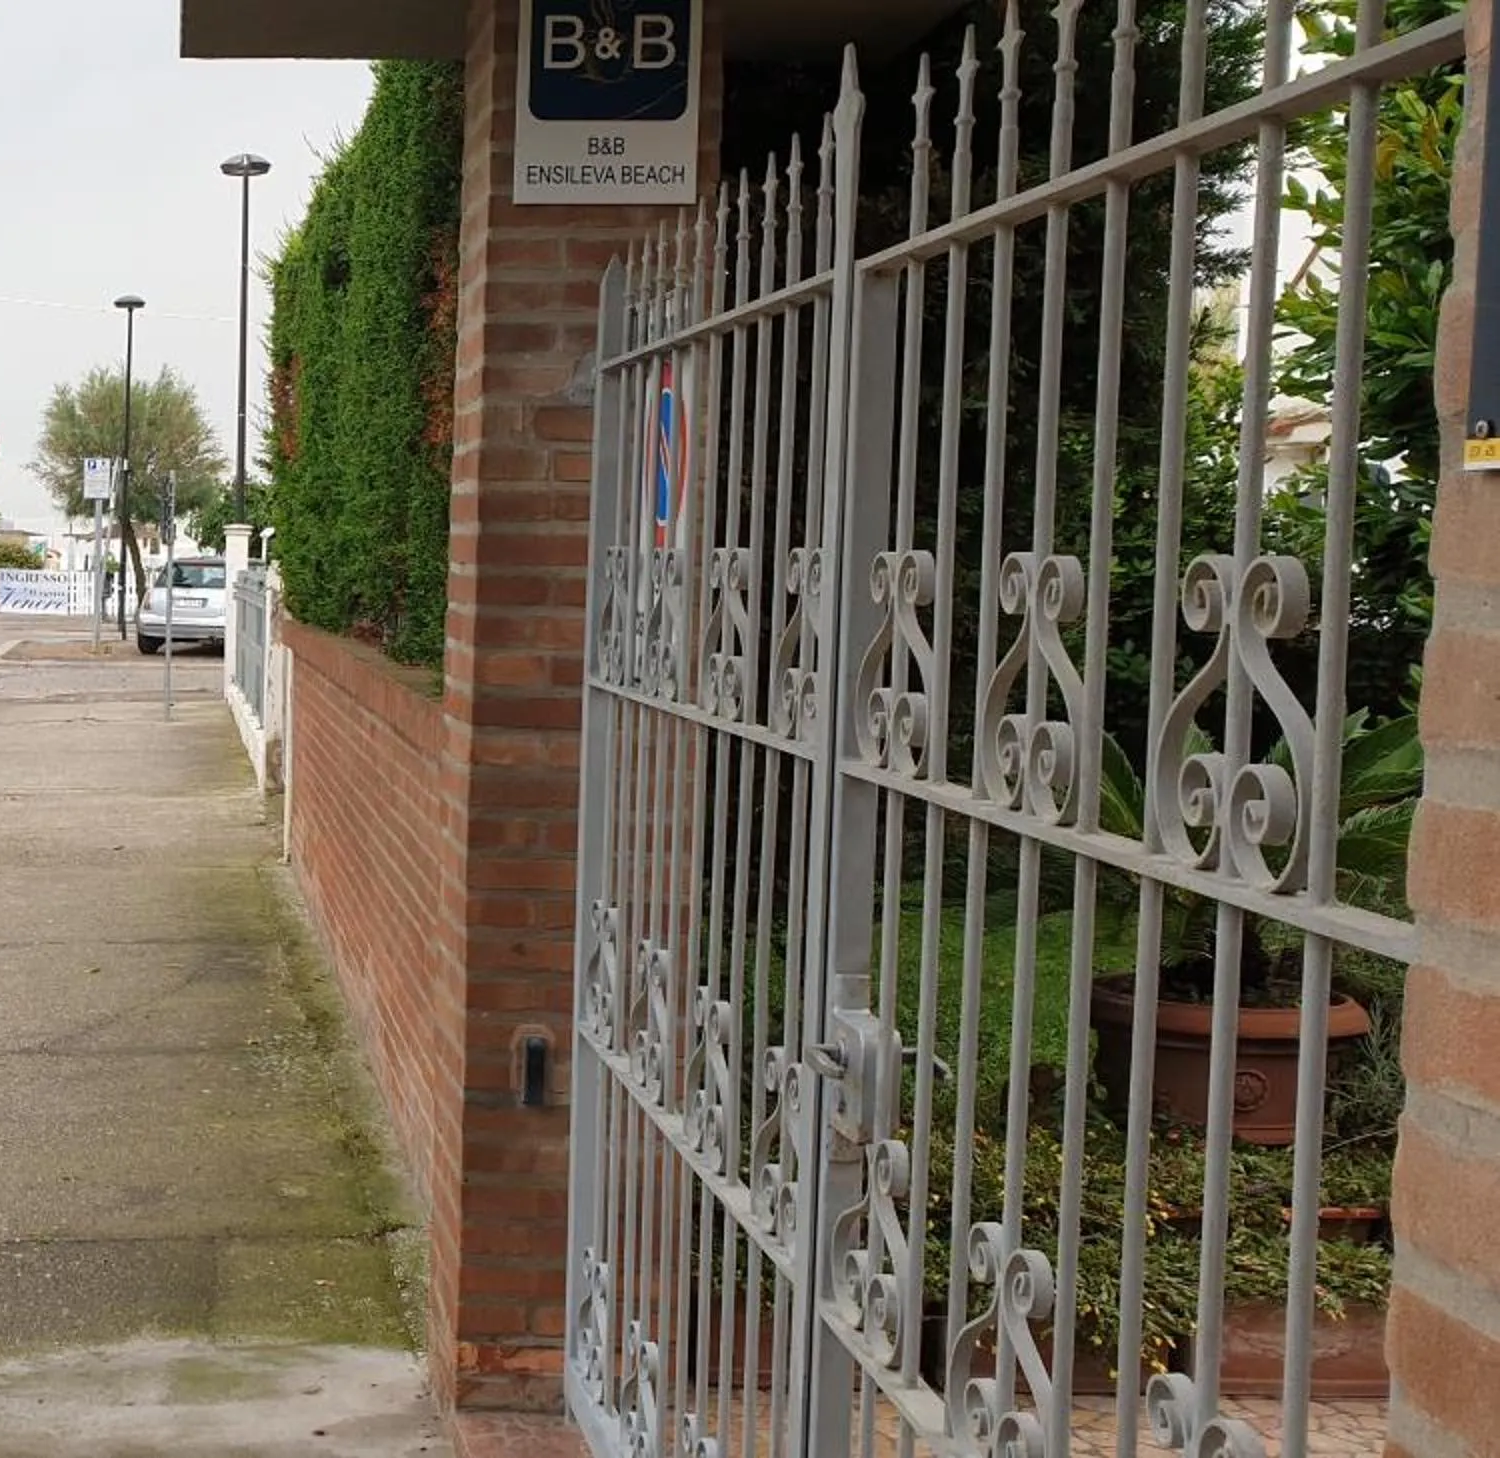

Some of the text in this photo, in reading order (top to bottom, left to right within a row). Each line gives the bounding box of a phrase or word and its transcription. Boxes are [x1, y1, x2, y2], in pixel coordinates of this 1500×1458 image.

[543, 14, 677, 69] B&B
[587, 136, 625, 155] B&B
[526, 164, 686, 186] ENSILEVA BEACH
